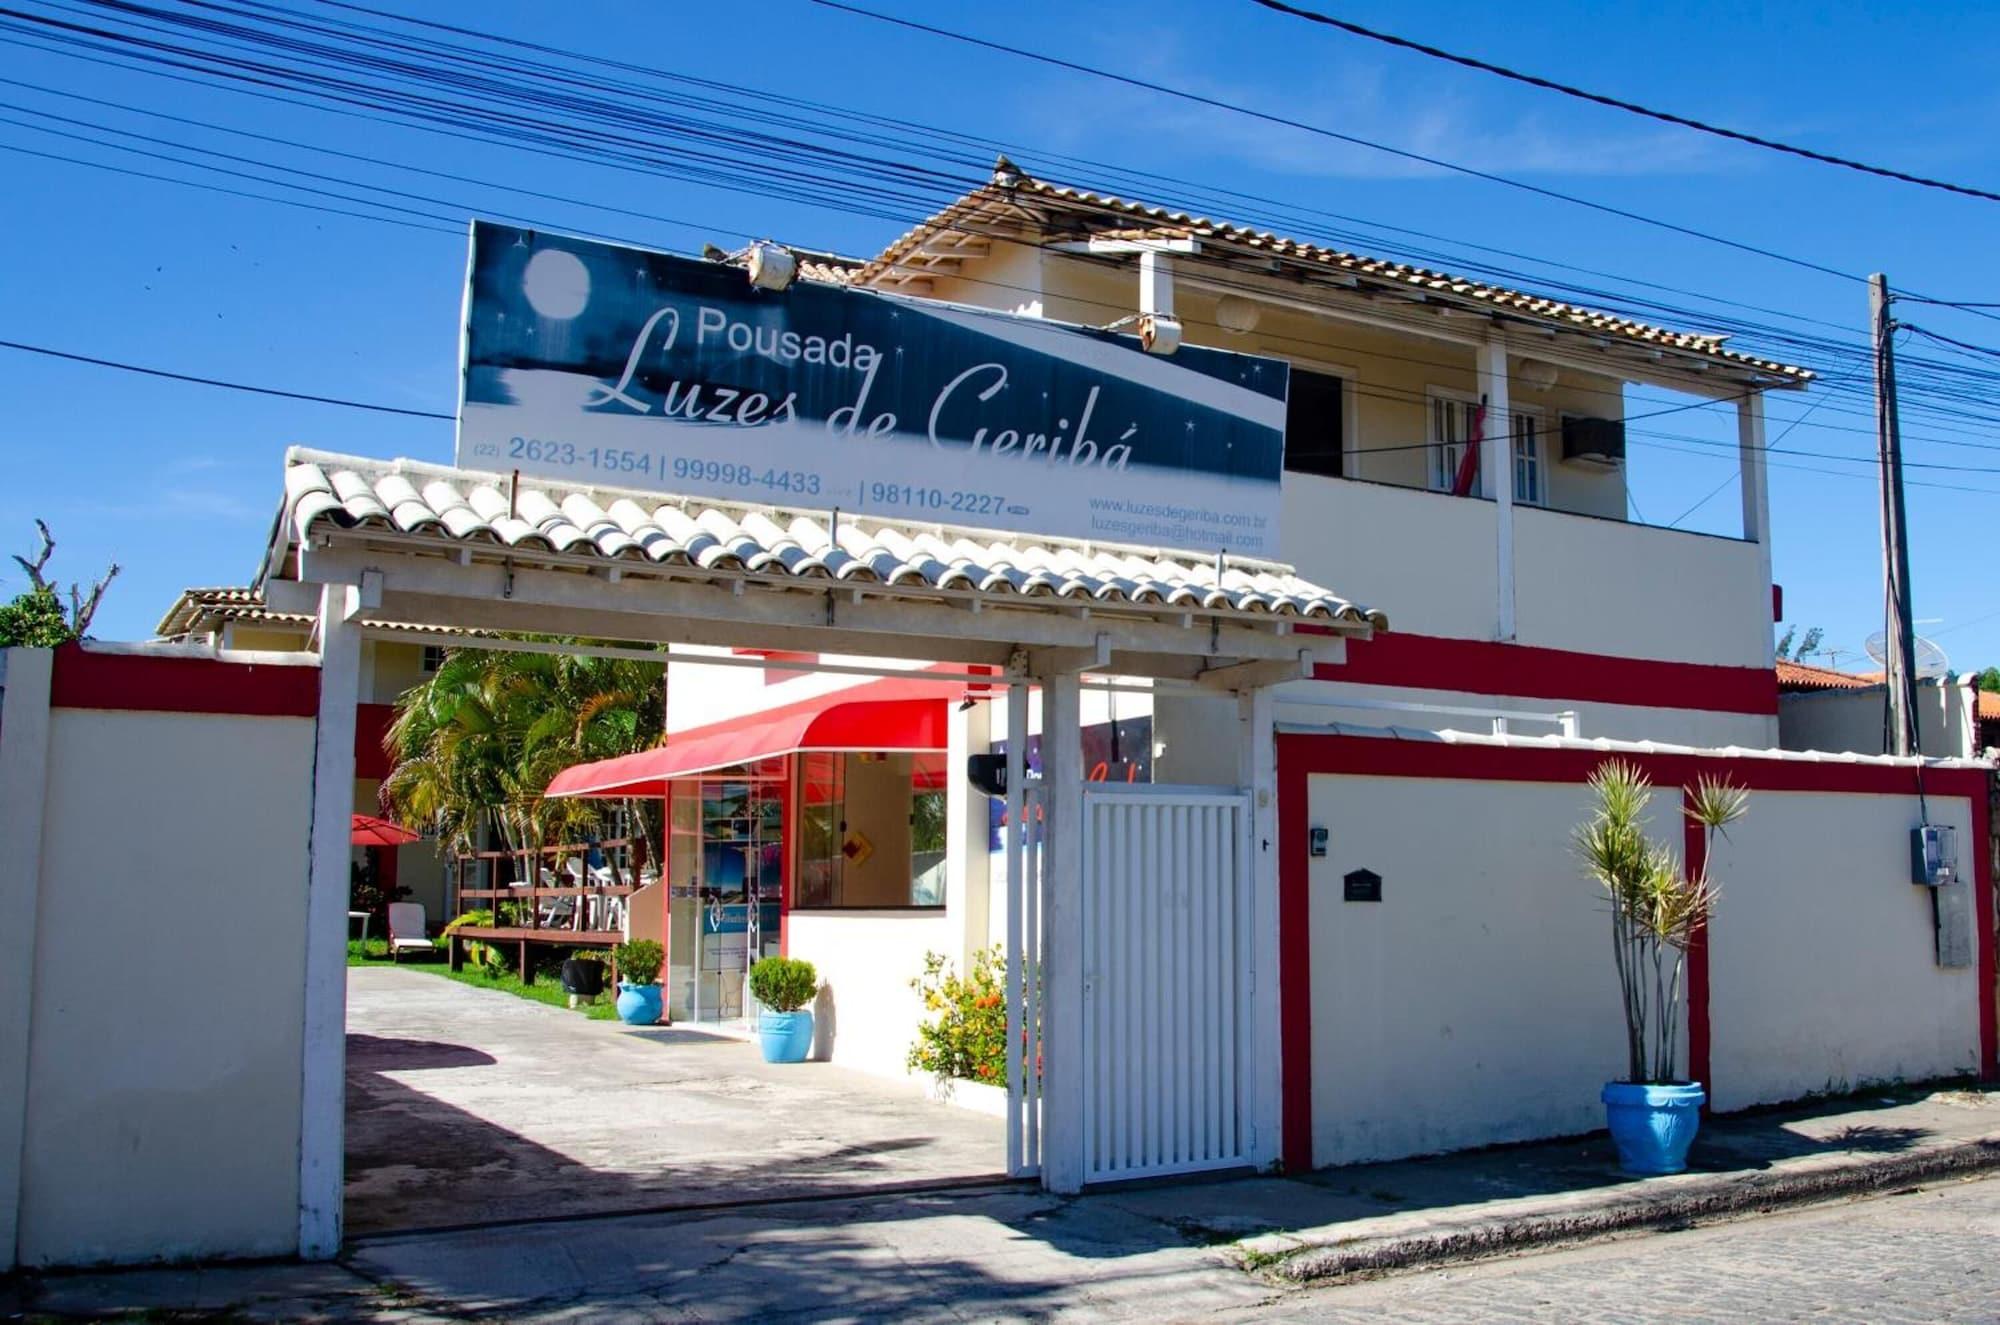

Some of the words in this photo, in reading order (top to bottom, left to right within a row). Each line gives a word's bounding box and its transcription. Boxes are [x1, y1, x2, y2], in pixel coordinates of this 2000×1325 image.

[697, 307, 879, 371] Pousada
[583, 307, 797, 427] Luzes
[826, 353, 898, 441] de
[927, 362, 1137, 474] Geribá
[473, 442, 500, 457] (22)
[509, 436, 651, 475] 2623-1554
[674, 457, 821, 495] 99998-4433
[872, 482, 1006, 516] 98110-2227
